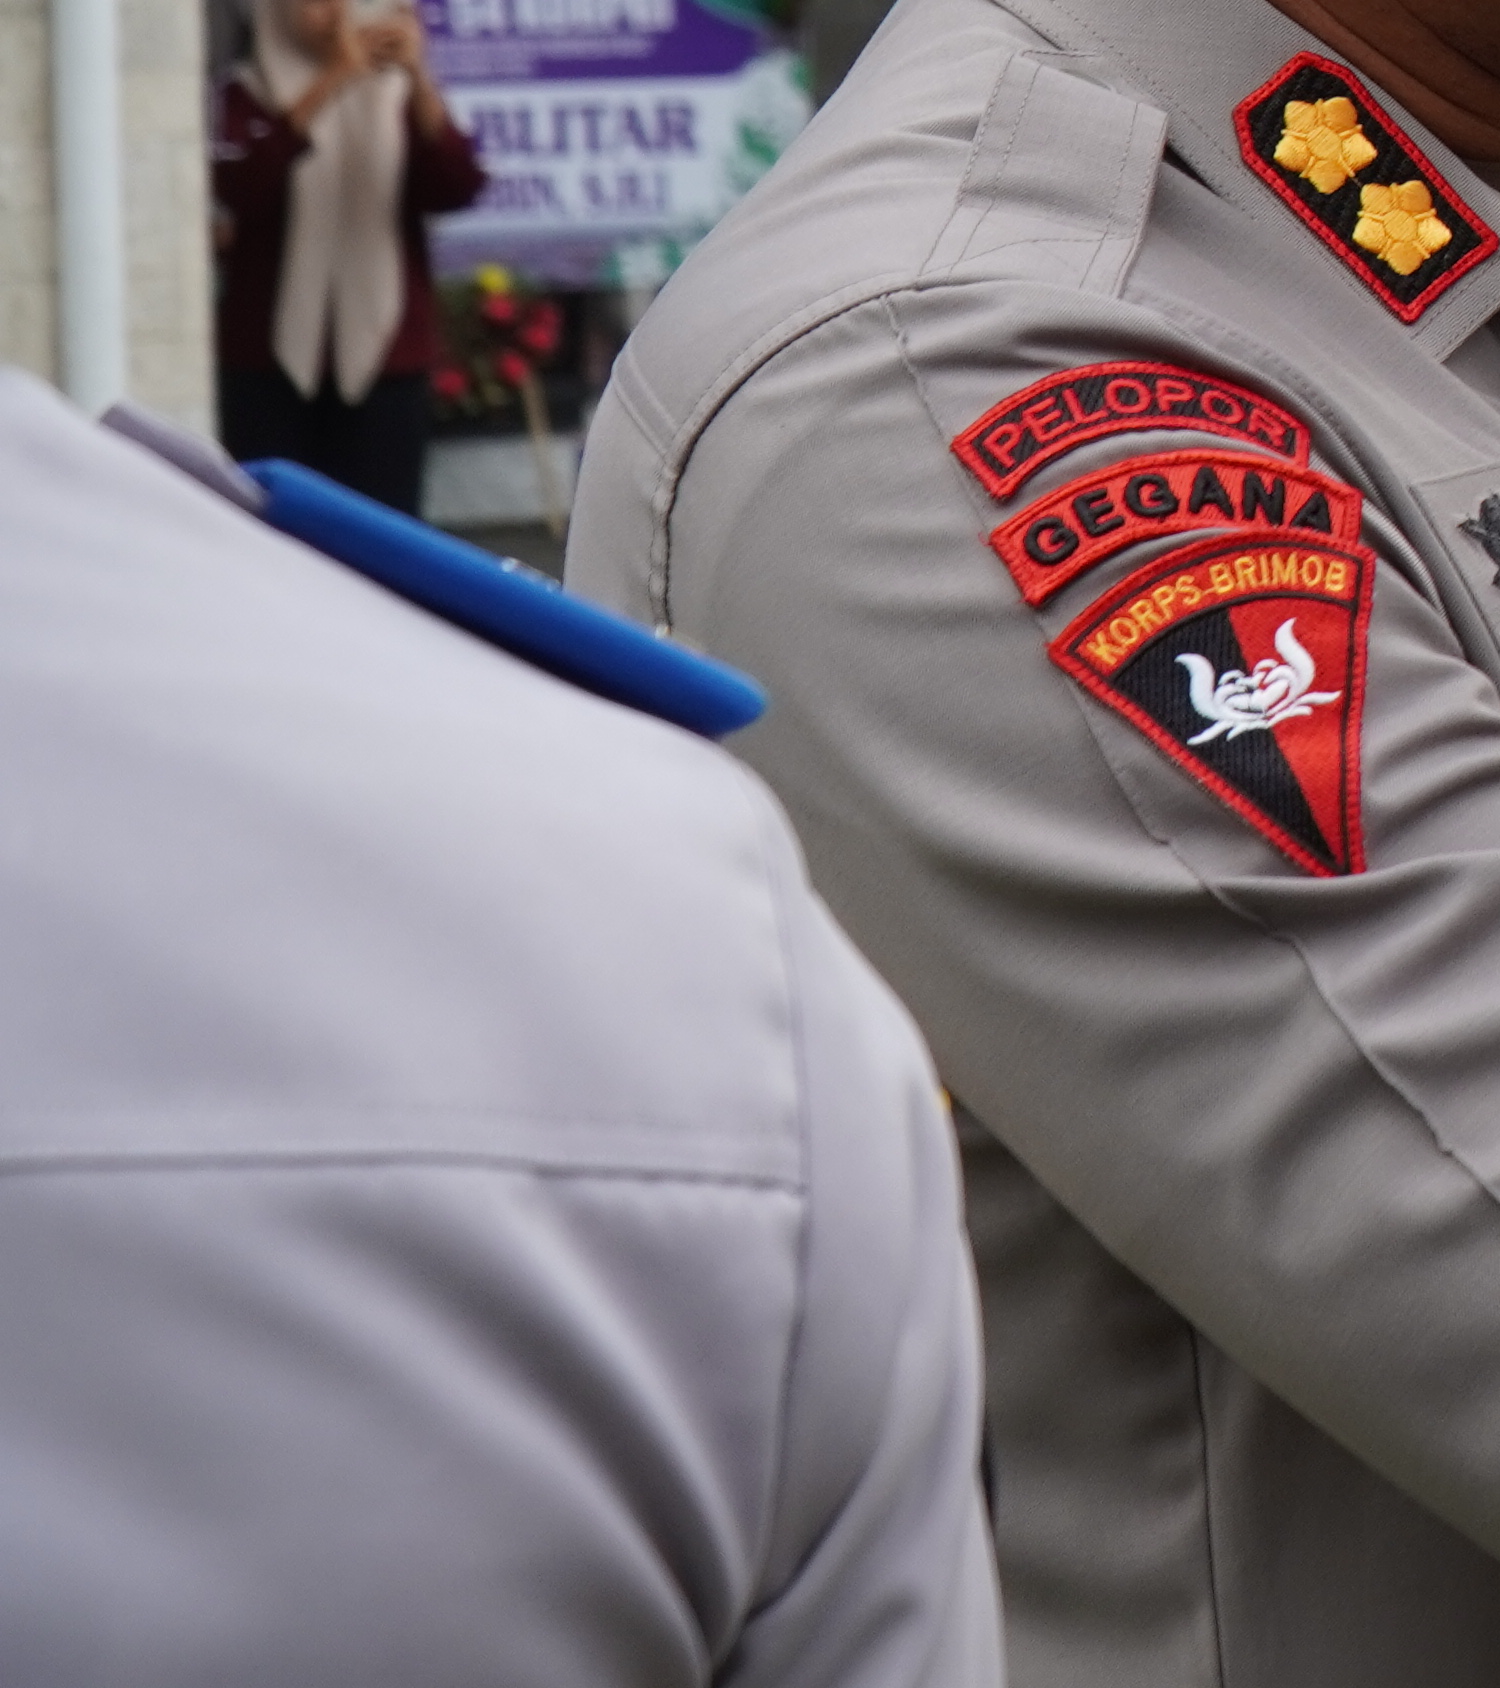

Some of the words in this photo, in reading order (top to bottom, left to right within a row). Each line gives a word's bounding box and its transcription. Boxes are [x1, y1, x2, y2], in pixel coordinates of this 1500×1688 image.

[983, 377, 1290, 470] PELOPOR
[1023, 466, 1332, 566] GEGANA
[1084, 574, 1207, 667] KORPS
[1207, 552, 1346, 597] BRIMOB
